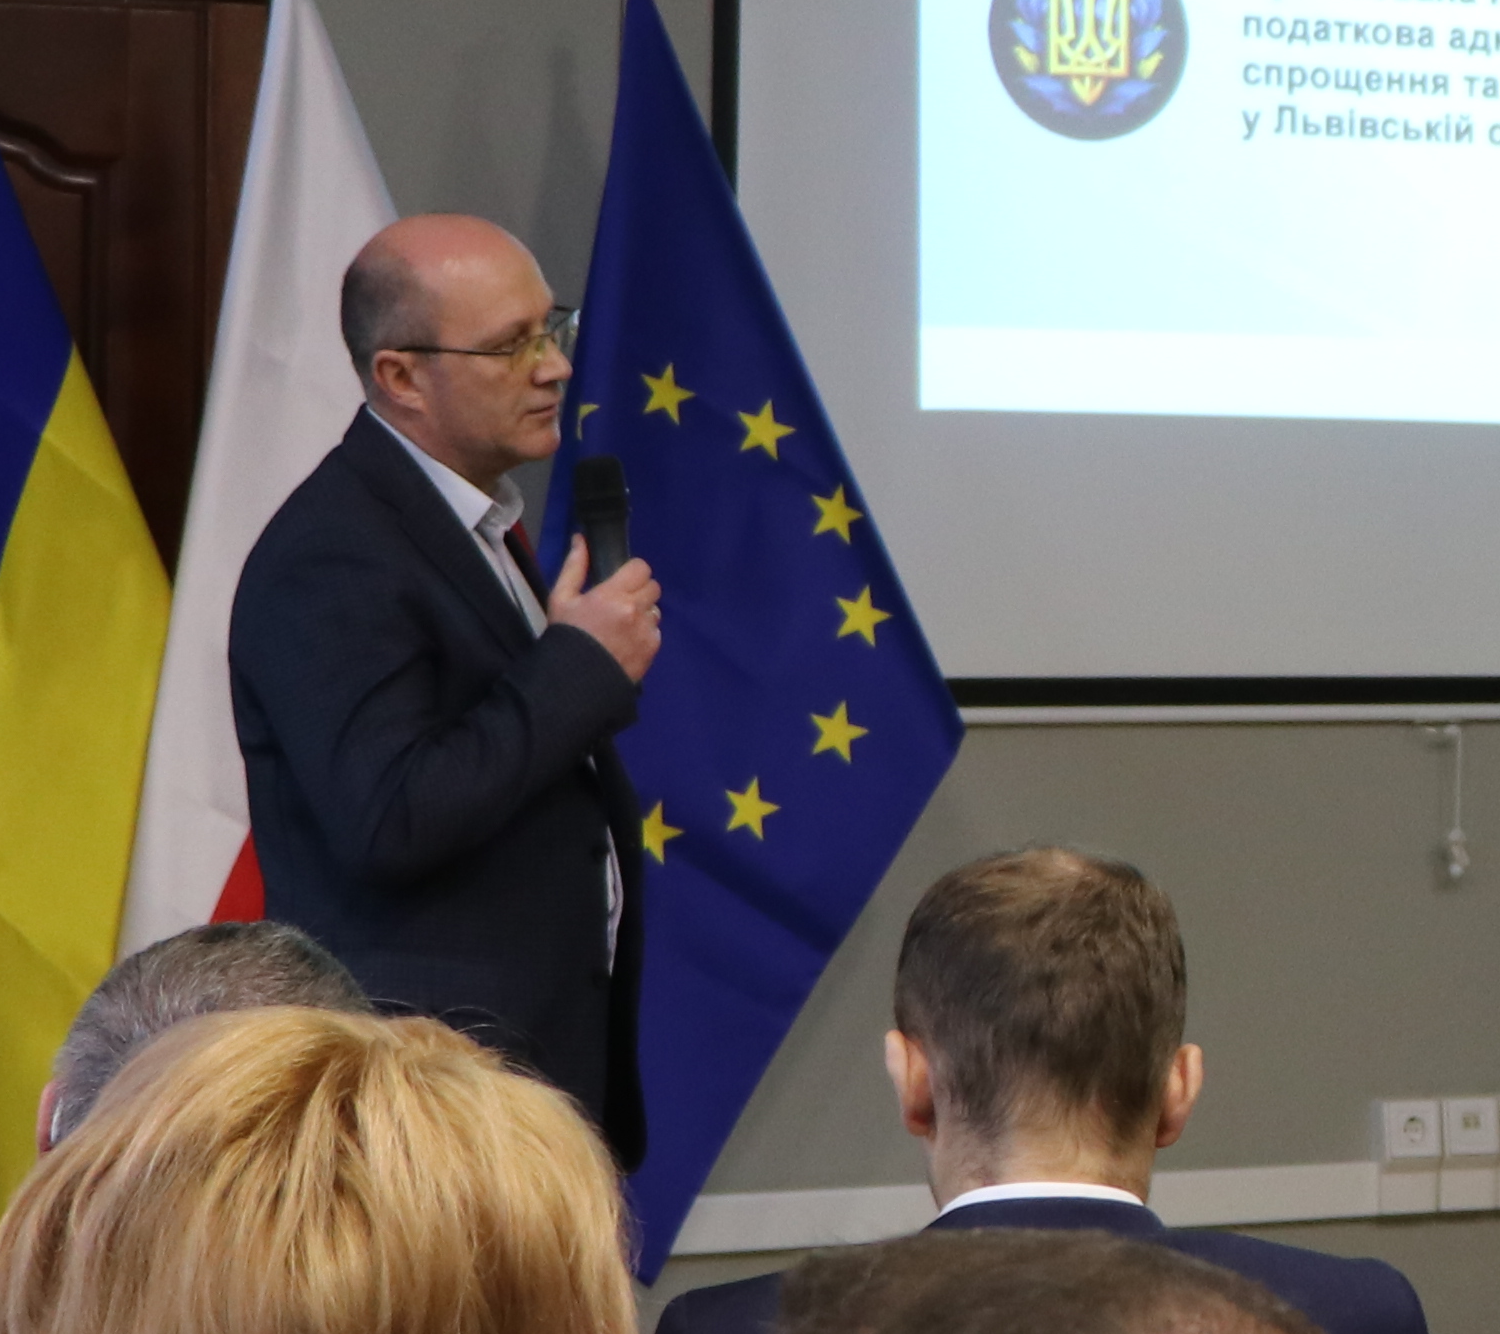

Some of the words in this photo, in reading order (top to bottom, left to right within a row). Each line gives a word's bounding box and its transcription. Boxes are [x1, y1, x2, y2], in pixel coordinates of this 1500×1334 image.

[1242, 14, 1435, 49] податкова
[1241, 61, 1450, 96] спрощення
[1463, 74, 1500, 100] та
[1241, 110, 1262, 143] у
[1273, 104, 1475, 144] Львівській
